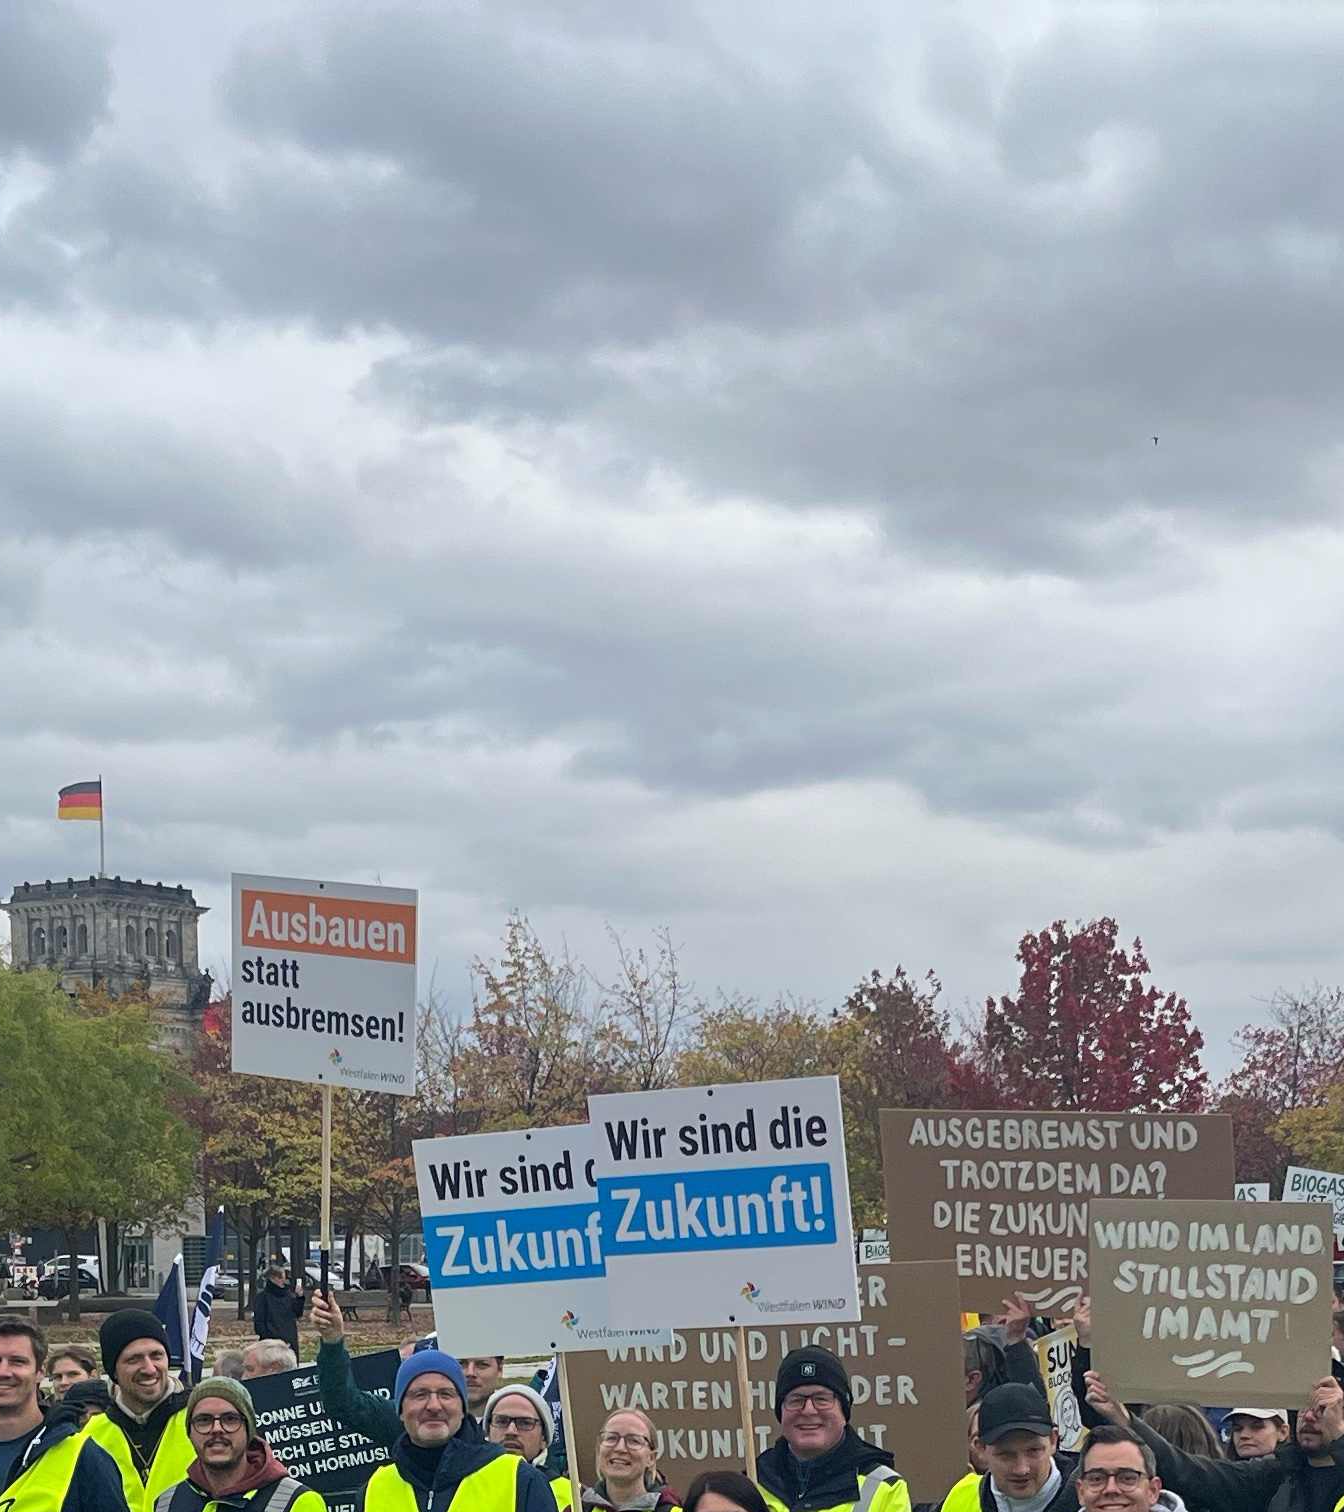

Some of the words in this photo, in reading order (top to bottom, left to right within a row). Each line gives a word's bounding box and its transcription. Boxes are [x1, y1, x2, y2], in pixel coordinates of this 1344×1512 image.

[248, 899, 405, 954] Ausbauen
[242, 956, 299, 989] statt
[242, 997, 404, 1043] ausbremsen!
[605, 1117, 666, 1161] Wir
[679, 1109, 755, 1156] sind
[769, 1106, 828, 1150] die
[909, 1118, 1124, 1151] AUSGEBREMST
[1129, 1121, 1198, 1152] UND
[429, 1160, 487, 1200] Wir
[500, 1150, 573, 1195] sind
[939, 1159, 1099, 1194] TROTZDEM
[1110, 1162, 1167, 1199] DA?
[610, 1175, 825, 1243] Zukunft!
[933, 1201, 982, 1233] DIE
[989, 1202, 1088, 1236] ZUKUN
[436, 1211, 602, 1277] Zukunf
[1094, 1221, 1180, 1250] WIND
[1188, 1222, 1229, 1251] IM
[956, 1243, 1088, 1281] ERNEUER
[1113, 1260, 1318, 1304] STILLSTAND
[1143, 1306, 1189, 1340] IM
[700, 1331, 768, 1364] UND
[600, 1381, 733, 1410] WARTEN
[851, 1375, 918, 1405] DER
[265, 1420, 333, 1445] MÜSSEN
[273, 1444, 304, 1462] RCH
[309, 1438, 337, 1455] DIE
[288, 1464, 311, 1479] ON
[316, 1447, 390, 1474] HORMUS!
